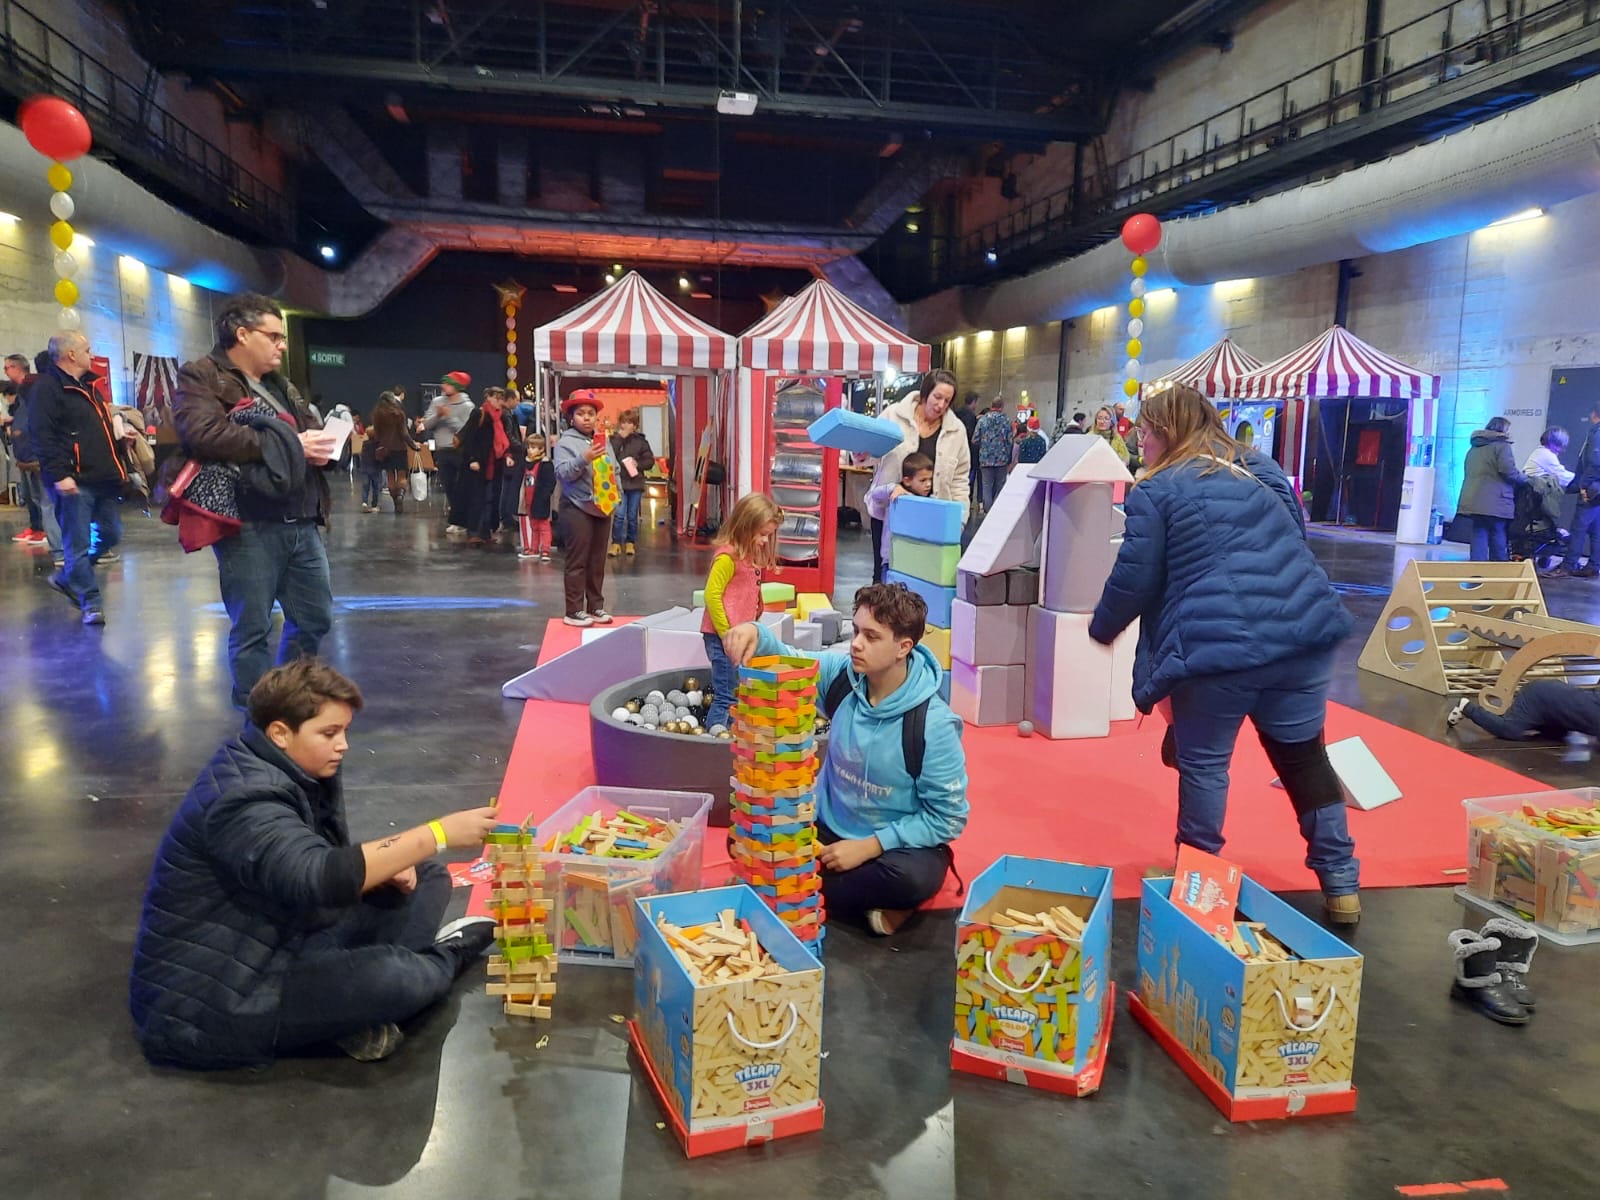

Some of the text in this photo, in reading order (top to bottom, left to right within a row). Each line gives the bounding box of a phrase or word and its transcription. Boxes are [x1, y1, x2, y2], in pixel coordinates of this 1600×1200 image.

[317, 352, 345, 365] SORTIE
[1287, 1056, 1309, 1066] 3XL
[746, 1079, 771, 1091] 3XL
